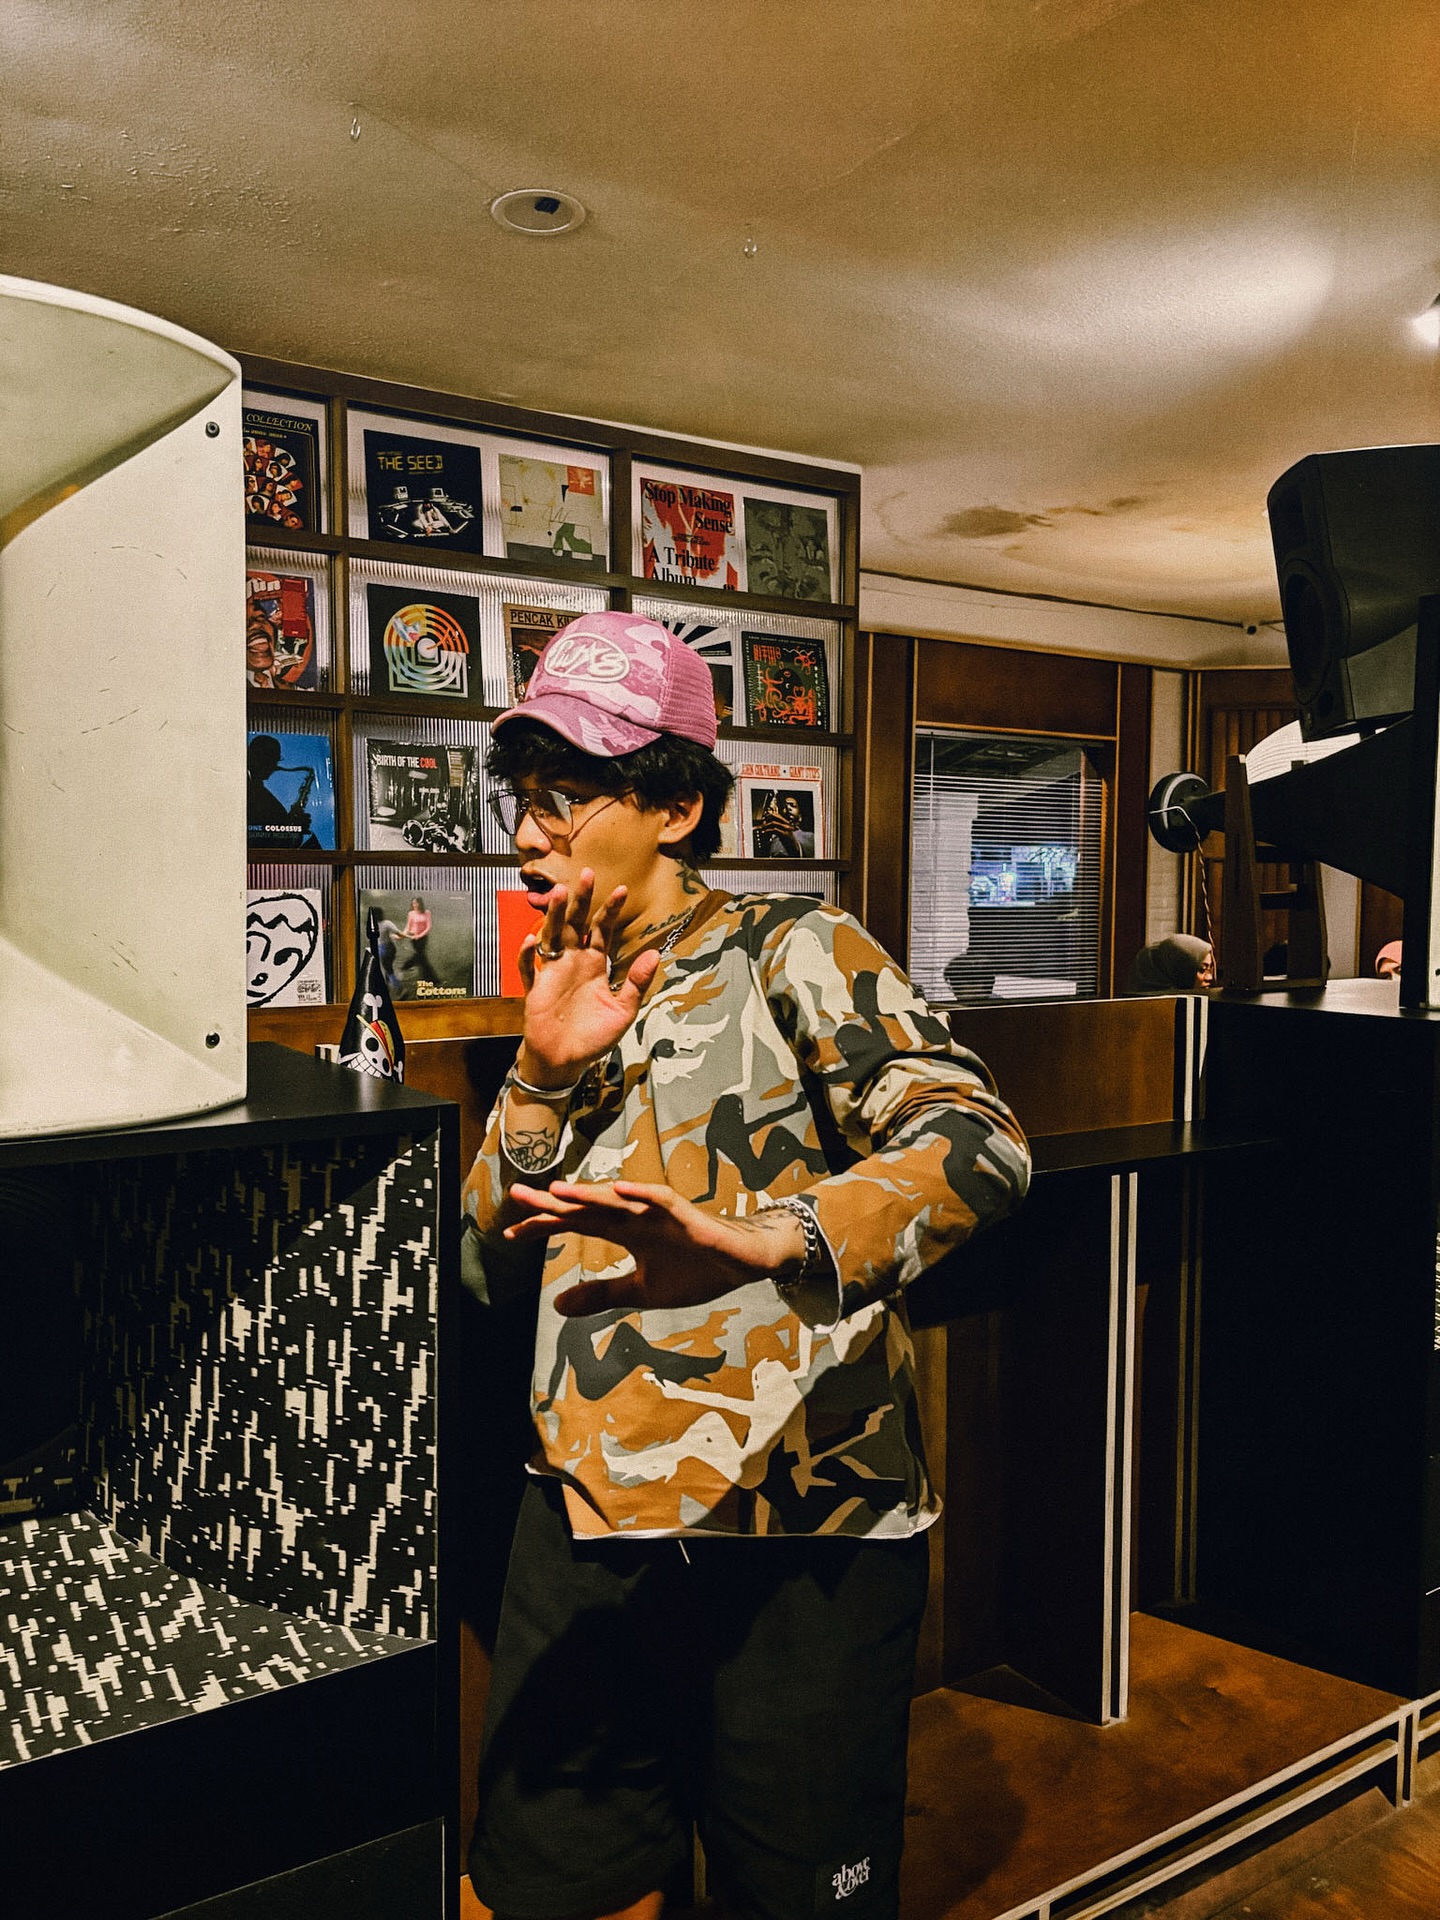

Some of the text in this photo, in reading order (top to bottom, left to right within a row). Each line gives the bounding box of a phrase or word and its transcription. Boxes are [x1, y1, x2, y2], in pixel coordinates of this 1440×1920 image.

[246, 413, 314, 432] COLLECTION
[377, 455, 404, 471] THE
[645, 482, 732, 518] Stop Making
[694, 510, 733, 534] Sense
[648, 545, 716, 571] A Tribute
[510, 611, 554, 627] PENCAK
[376, 754, 438, 769] BIRTH OF THE COOL
[264, 824, 302, 833] COLOSSUS
[416, 986, 467, 997] Cottons
